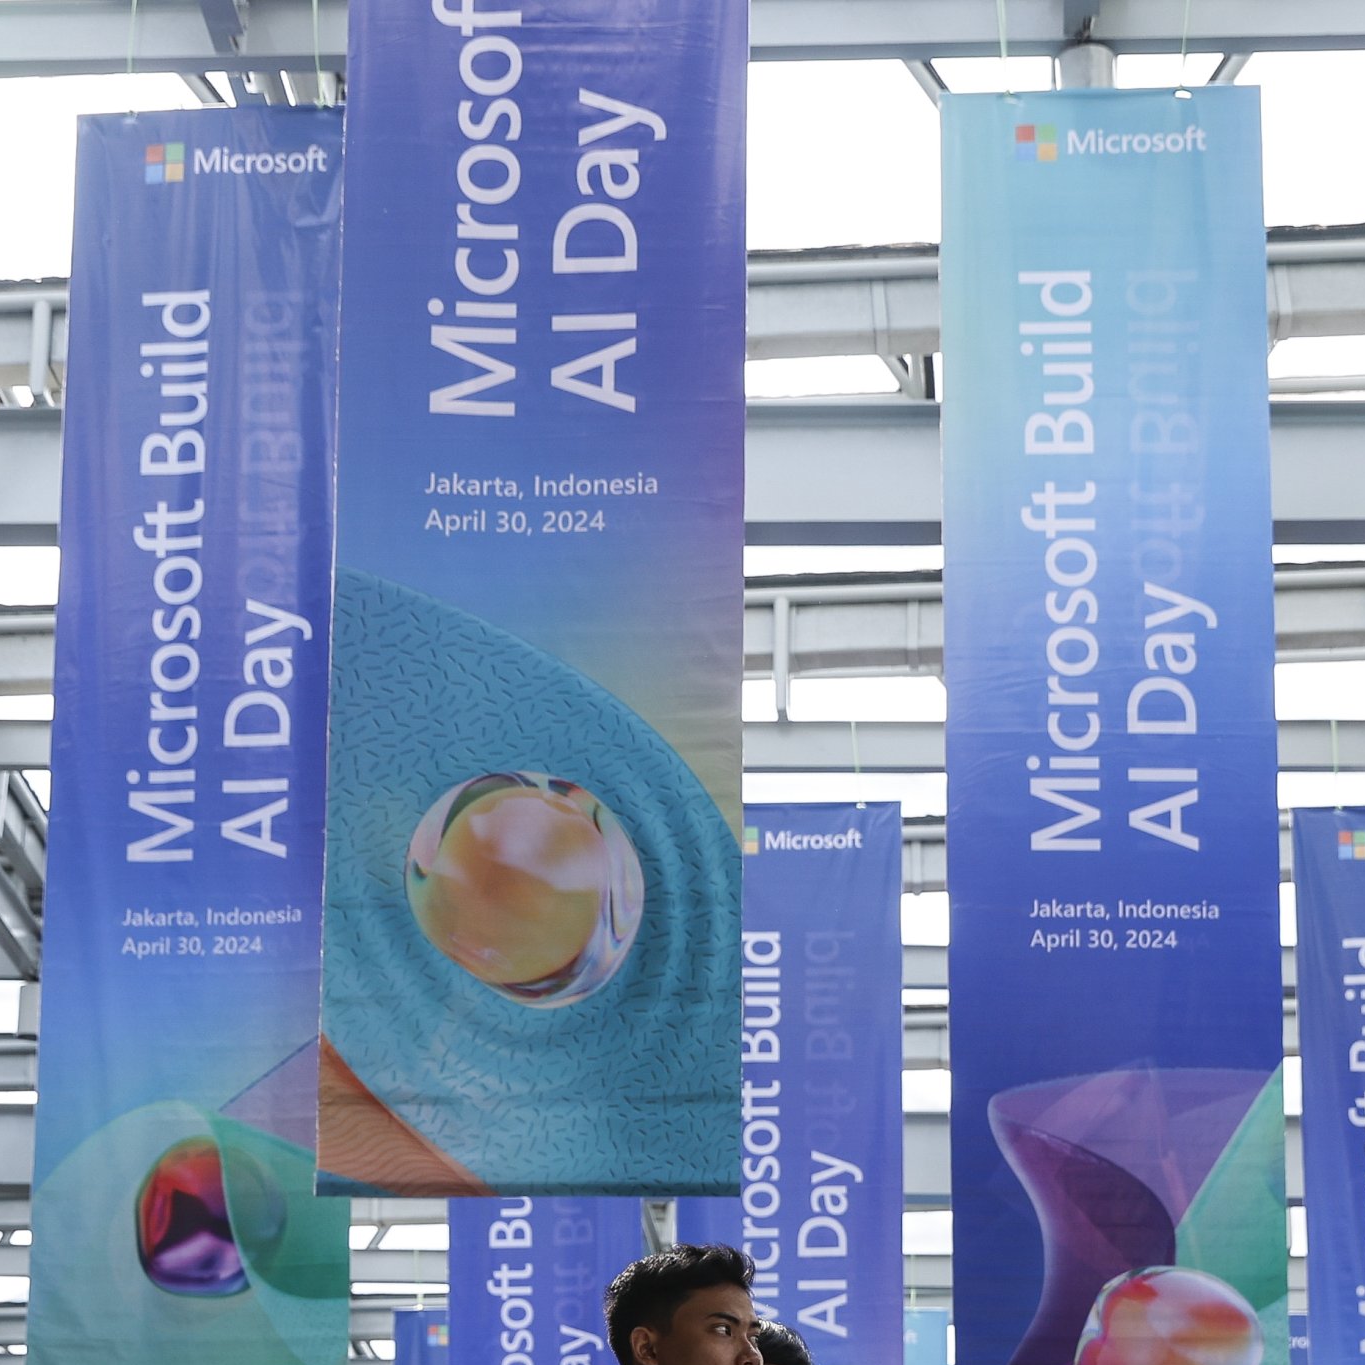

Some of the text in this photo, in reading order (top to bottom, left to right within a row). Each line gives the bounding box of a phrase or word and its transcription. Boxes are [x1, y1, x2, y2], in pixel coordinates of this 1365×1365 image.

[194, 146, 326, 174] Microsoft
[1067, 126, 1206, 154] Microsoft
[428, 0, 522, 416] Microsof
[551, 88, 666, 412] AI Day
[424, 508, 606, 537] April 30, 2024
[425, 471, 658, 500] Jakarta, Indonesia
[127, 290, 210, 861] Microsoft Build
[1019, 271, 1099, 850] Microsoft Build
[224, 598, 312, 747] Day
[1127, 581, 1217, 734] Day
[221, 778, 288, 858] AI
[765, 828, 861, 849] Microsoft
[1128, 768, 1199, 850] AI
[121, 935, 263, 960] April 30, 2024
[122, 905, 302, 927] Jakarta, Indonesia
[1029, 898, 1220, 921] Jakarta, Indonesia
[1030, 929, 1178, 953] April 30, 2024
[742, 932, 781, 1061] Build
[797, 1151, 863, 1338] AI Day
